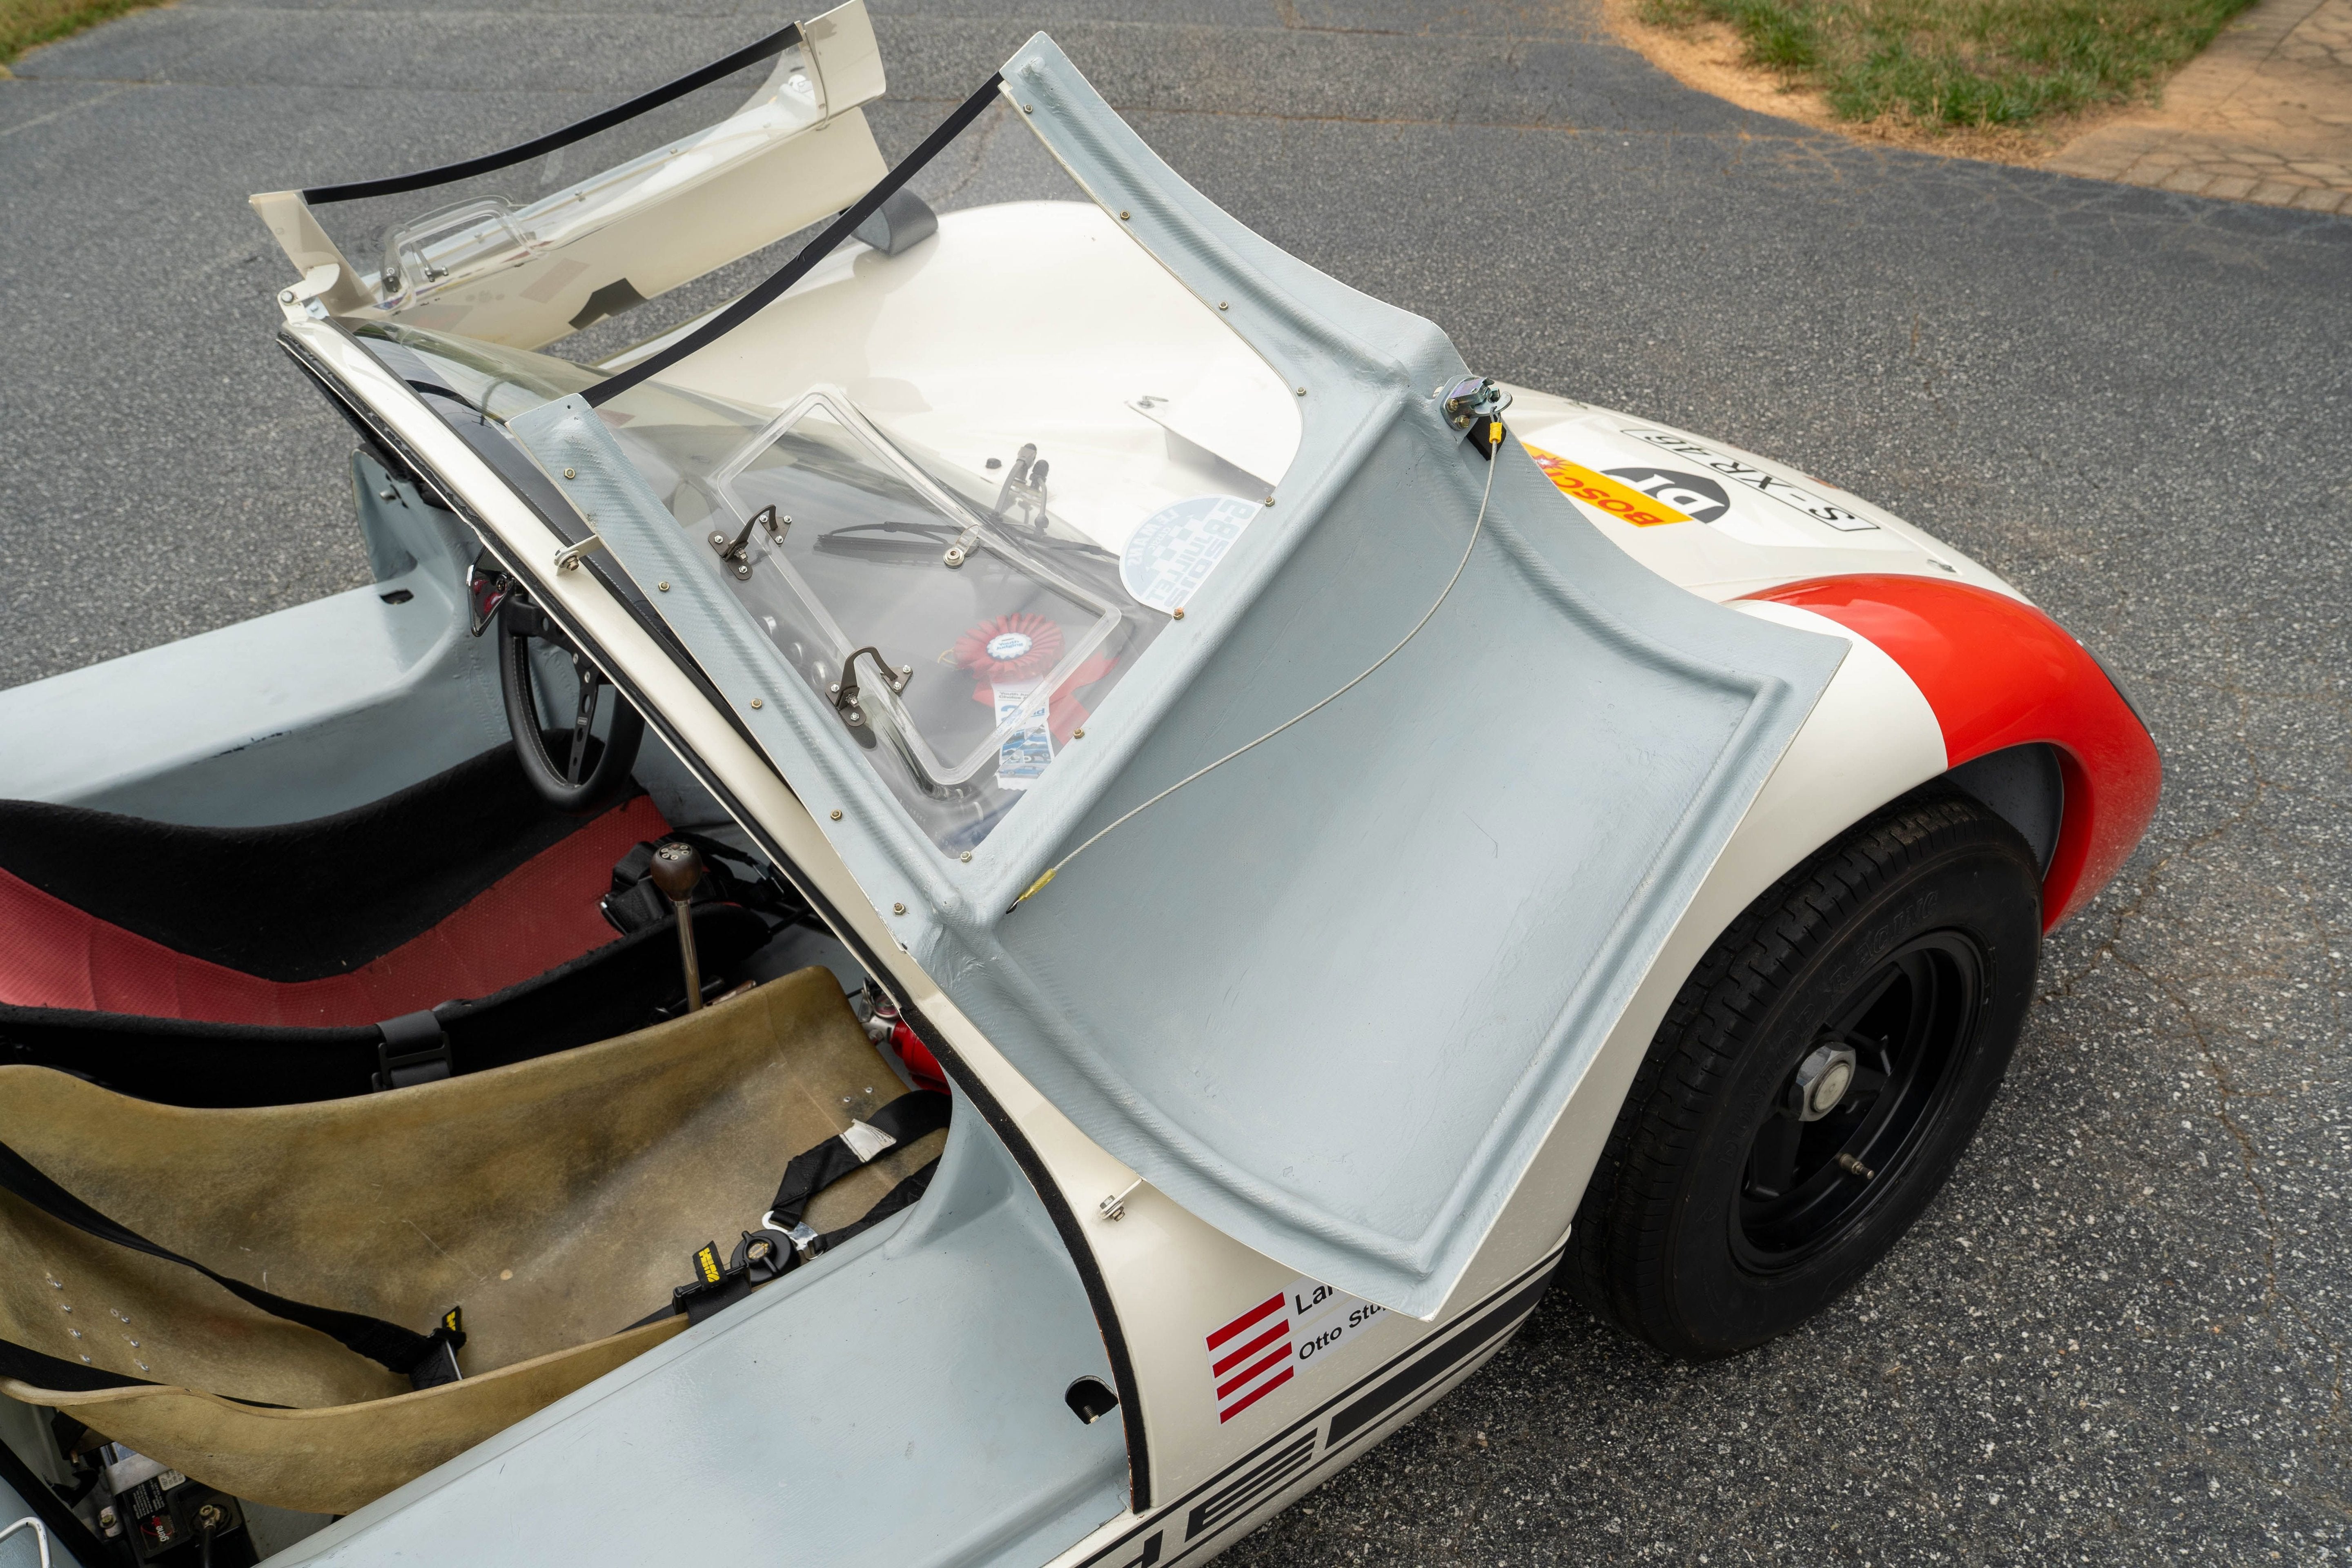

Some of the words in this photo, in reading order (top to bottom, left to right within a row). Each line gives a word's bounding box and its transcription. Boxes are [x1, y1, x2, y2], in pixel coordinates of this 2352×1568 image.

[1717, 1003, 1815, 1168] DUNLOP
[1827, 890, 1939, 993] RACING
[1299, 1327, 1342, 1360] Otto
[1349, 1304, 1388, 1328] Stu
